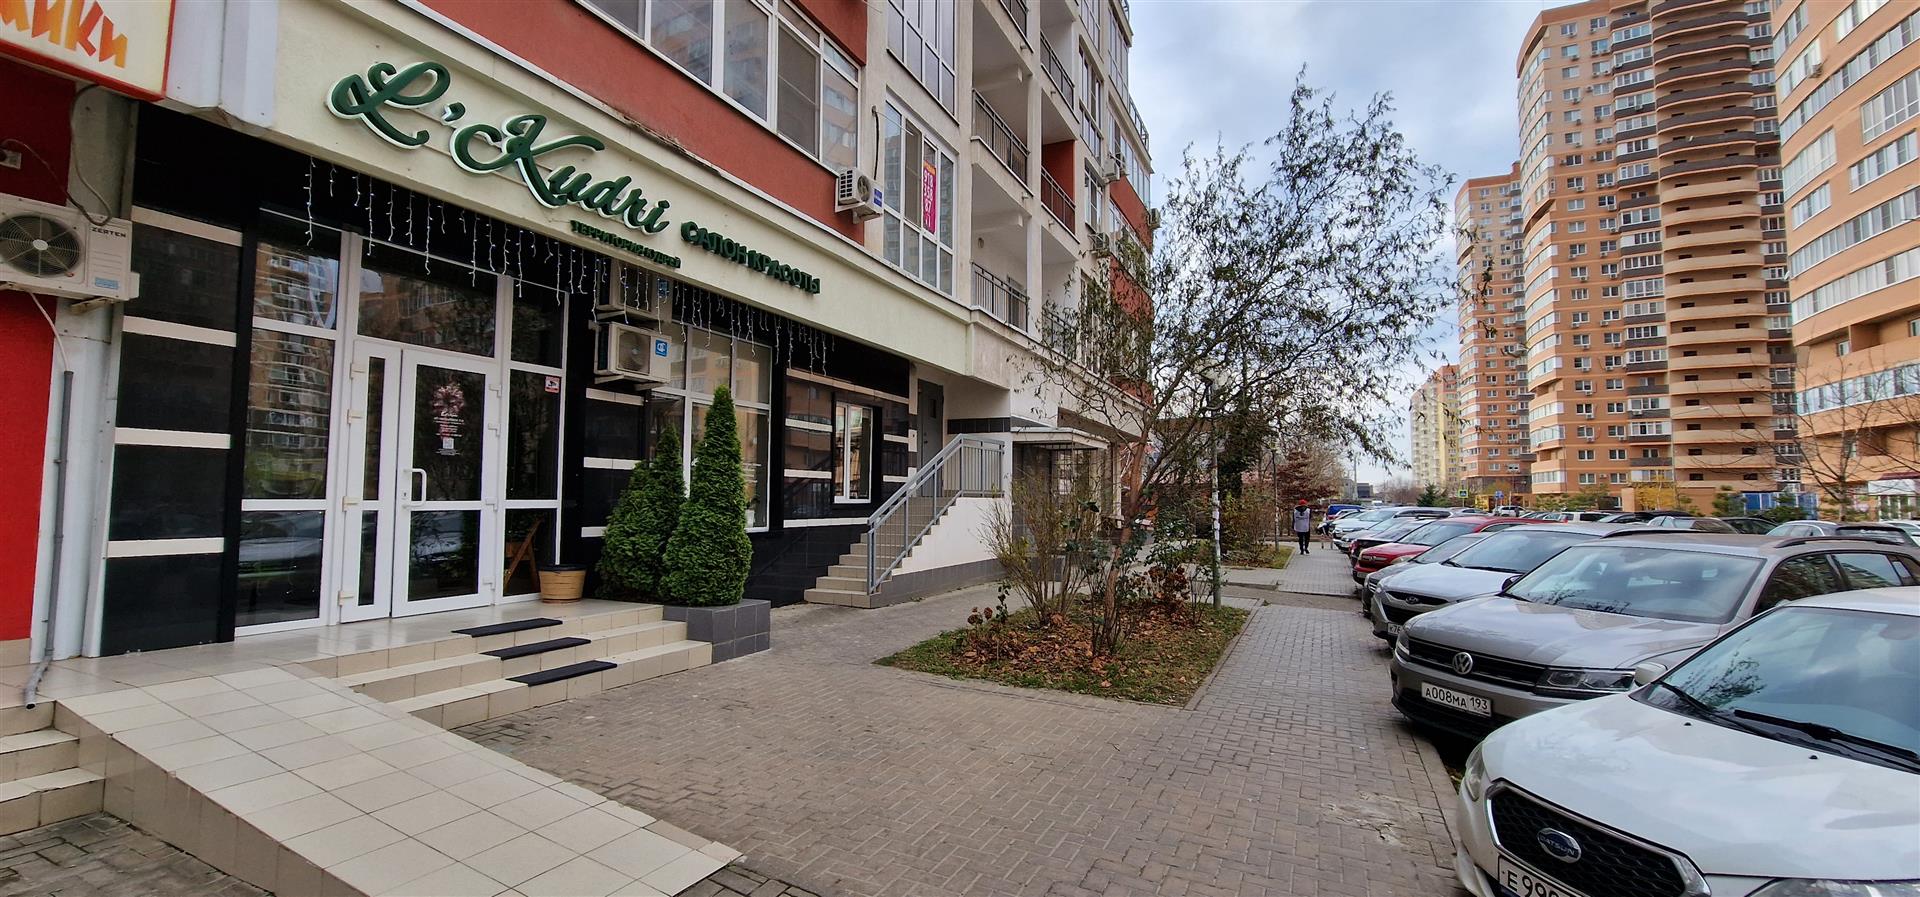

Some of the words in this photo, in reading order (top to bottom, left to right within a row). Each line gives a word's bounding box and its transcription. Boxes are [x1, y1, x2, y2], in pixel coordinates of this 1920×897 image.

[91, 226, 127, 238] ZERTEN
[680, 221, 747, 265] САЛОН
[747, 250, 820, 294] КРАСОТЫ
[1425, 687, 1467, 708] А008МА
[1470, 697, 1488, 710] 193
